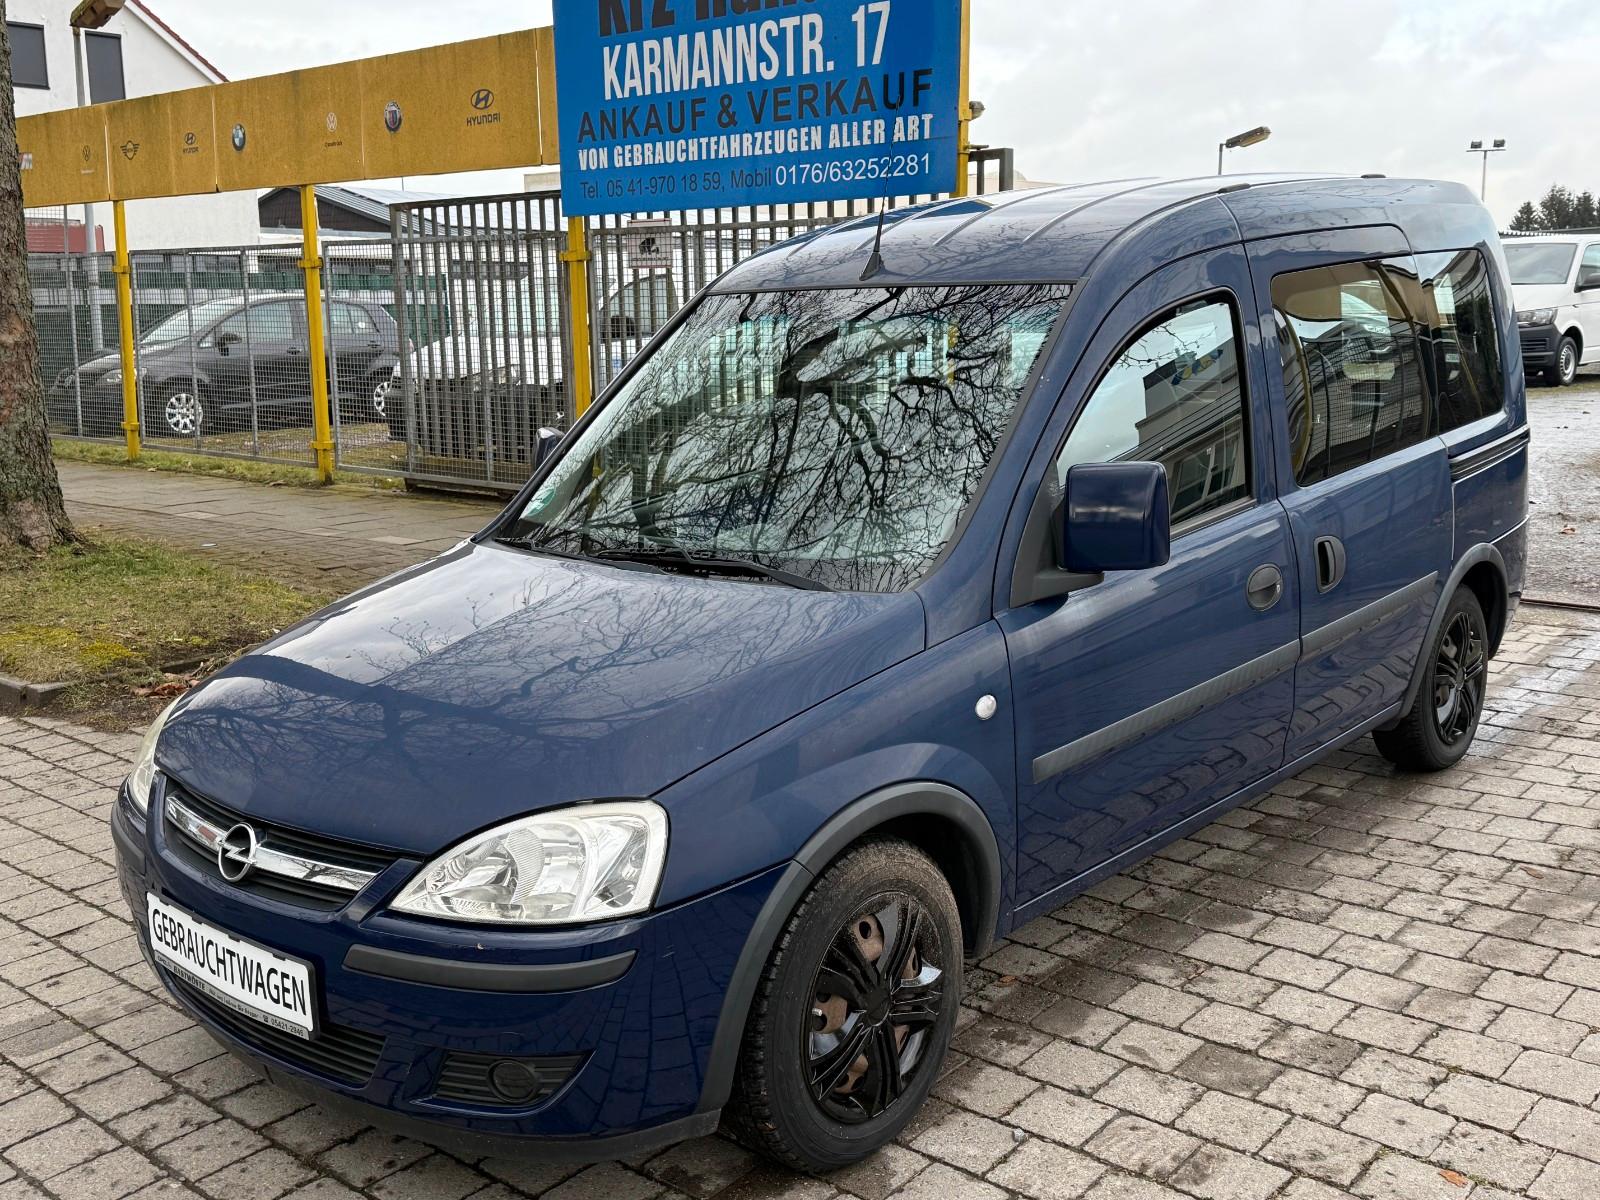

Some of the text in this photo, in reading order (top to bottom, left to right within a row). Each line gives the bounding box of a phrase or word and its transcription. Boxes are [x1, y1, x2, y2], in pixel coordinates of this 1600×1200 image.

[603, 0, 890, 100] KARMANNSTR. 17
[466, 112, 501, 127] HYUNDAI
[578, 68, 933, 144] ANKAUF & VERKAUF
[578, 113, 933, 171] VON GEBRAUCHTFAHRZEUGEN ALLER ART
[580, 181, 602, 200] Tel.
[606, 179, 624, 198] 05
[627, 175, 675, 196] 41-970
[682, 174, 699, 193] 18
[731, 168, 772, 190] Mobil
[775, 153, 931, 186] 0176/63252281
[152, 908, 308, 1017] GEBRAUCHTWAGEN
